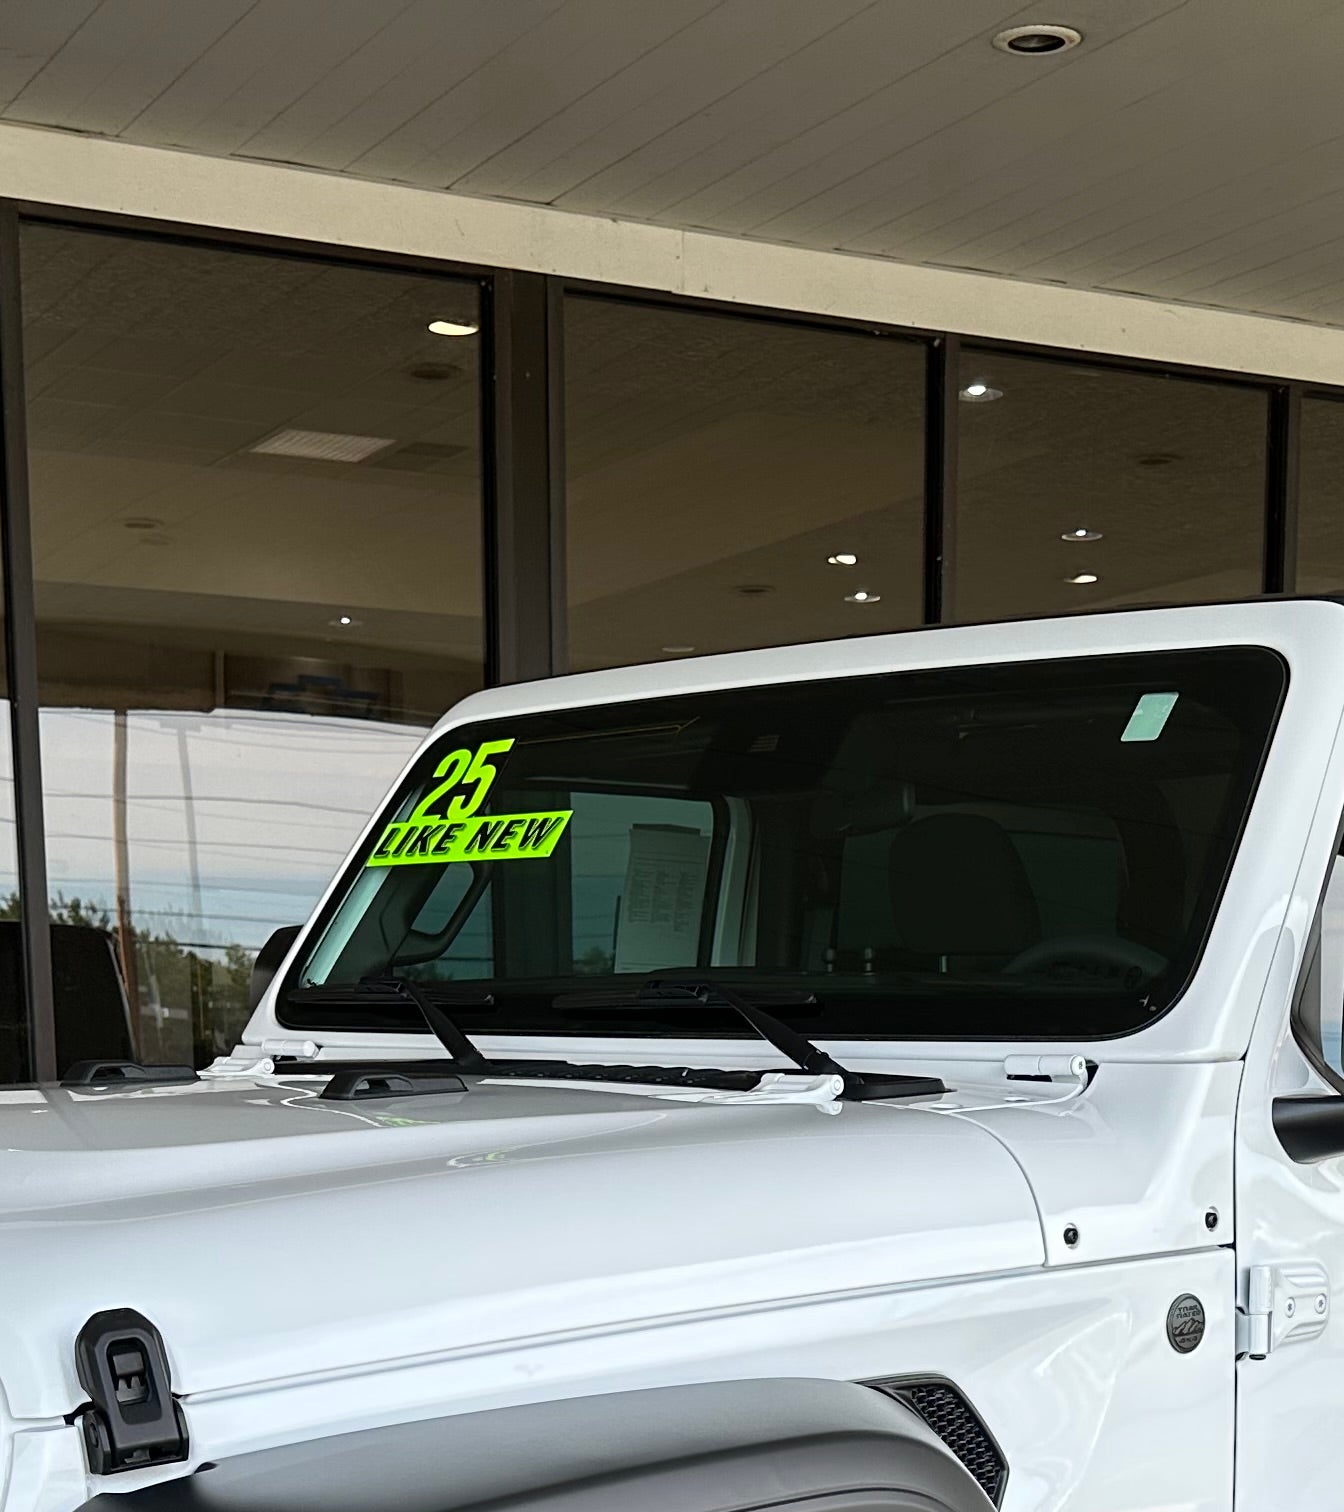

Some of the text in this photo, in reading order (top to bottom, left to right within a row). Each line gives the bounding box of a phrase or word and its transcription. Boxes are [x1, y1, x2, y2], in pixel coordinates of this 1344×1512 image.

[408, 738, 515, 822] 25
[374, 816, 563, 858] LIKE NEW
